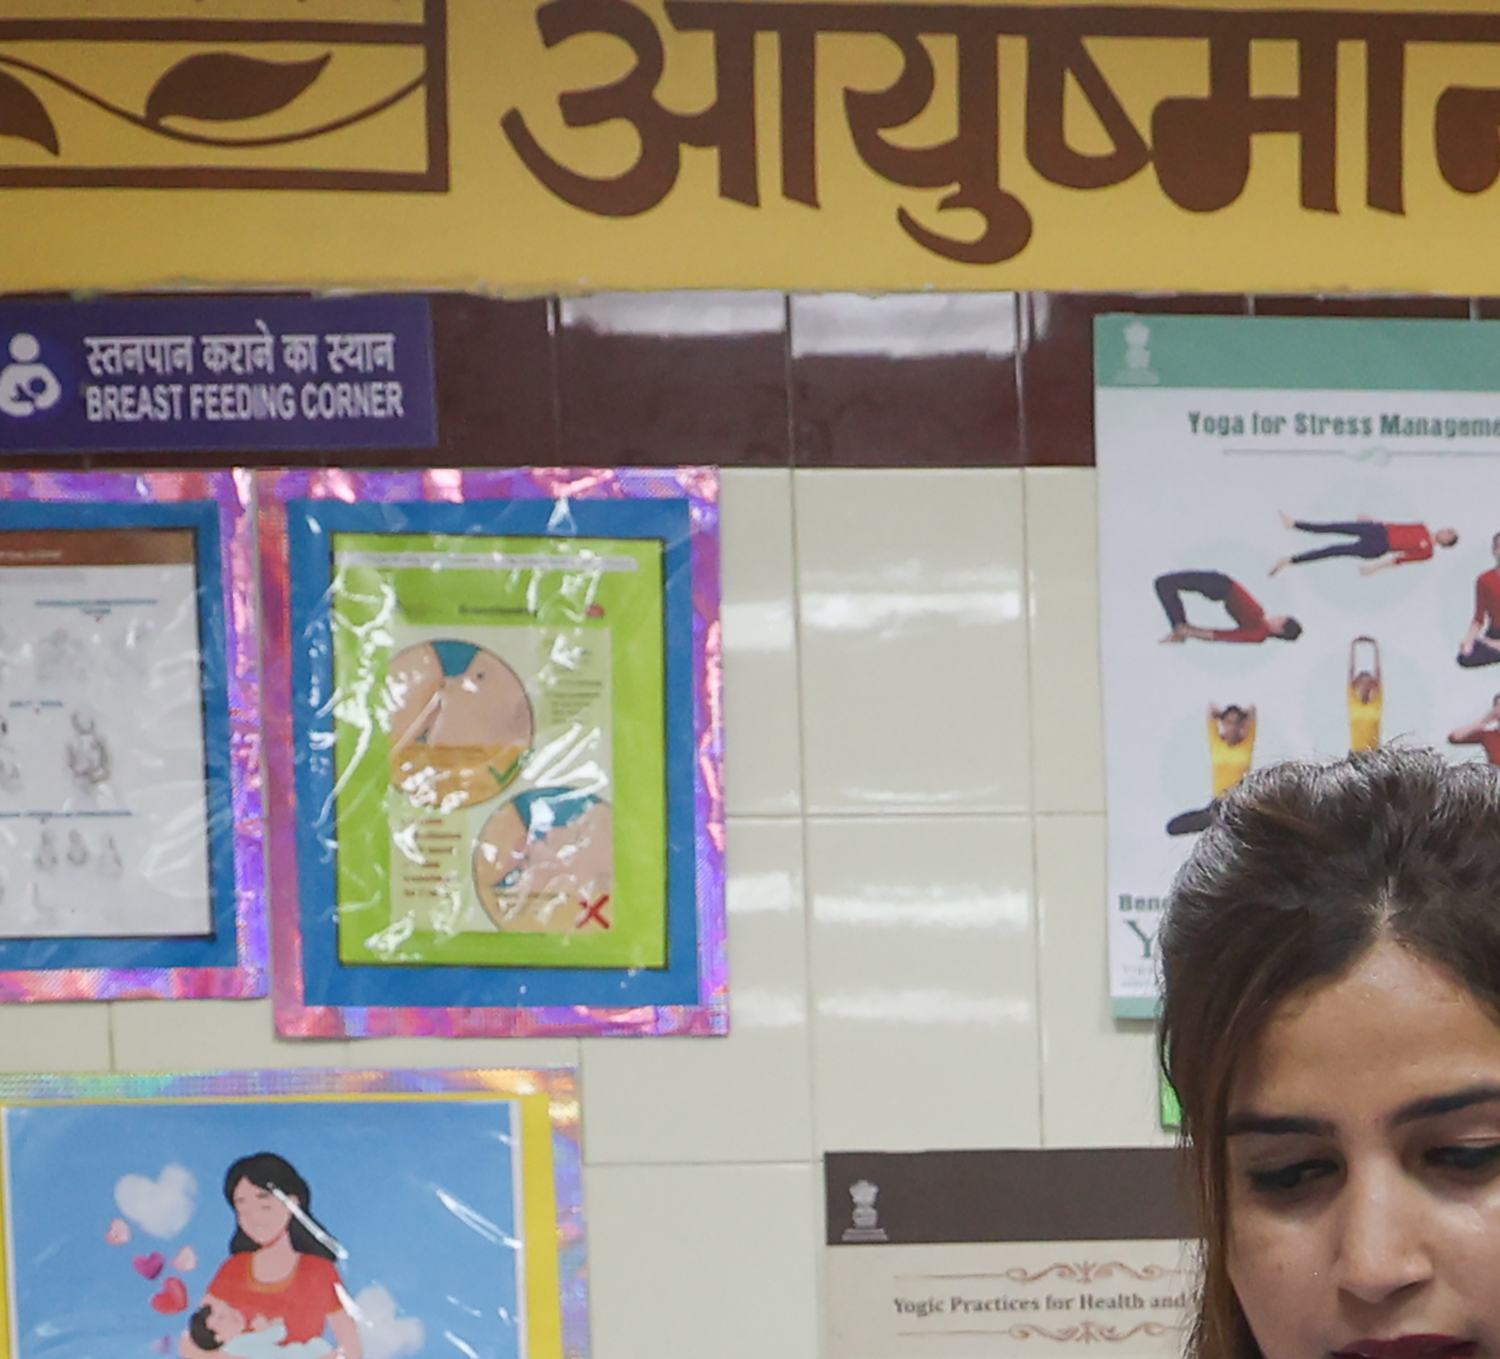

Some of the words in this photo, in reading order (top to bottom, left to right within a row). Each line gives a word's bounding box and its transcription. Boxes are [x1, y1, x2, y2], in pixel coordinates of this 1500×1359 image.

[84, 335, 194, 377] स्तनपान
[201, 318, 277, 376] कराने
[281, 332, 321, 374] का
[325, 332, 396, 374] स्थान
[85, 385, 183, 423] BREAST
[189, 383, 298, 421] FEEDING
[301, 382, 404, 420] CORNER
[1189, 411, 1245, 437] Yoga
[1252, 412, 1287, 435] for
[1295, 413, 1373, 436] Stress
[894, 1297, 945, 1318] Yogic
[950, 1295, 1040, 1313] Practices
[1045, 1295, 1073, 1311] for
[1080, 1293, 1145, 1311] Health
[1150, 1293, 1187, 1309] and
